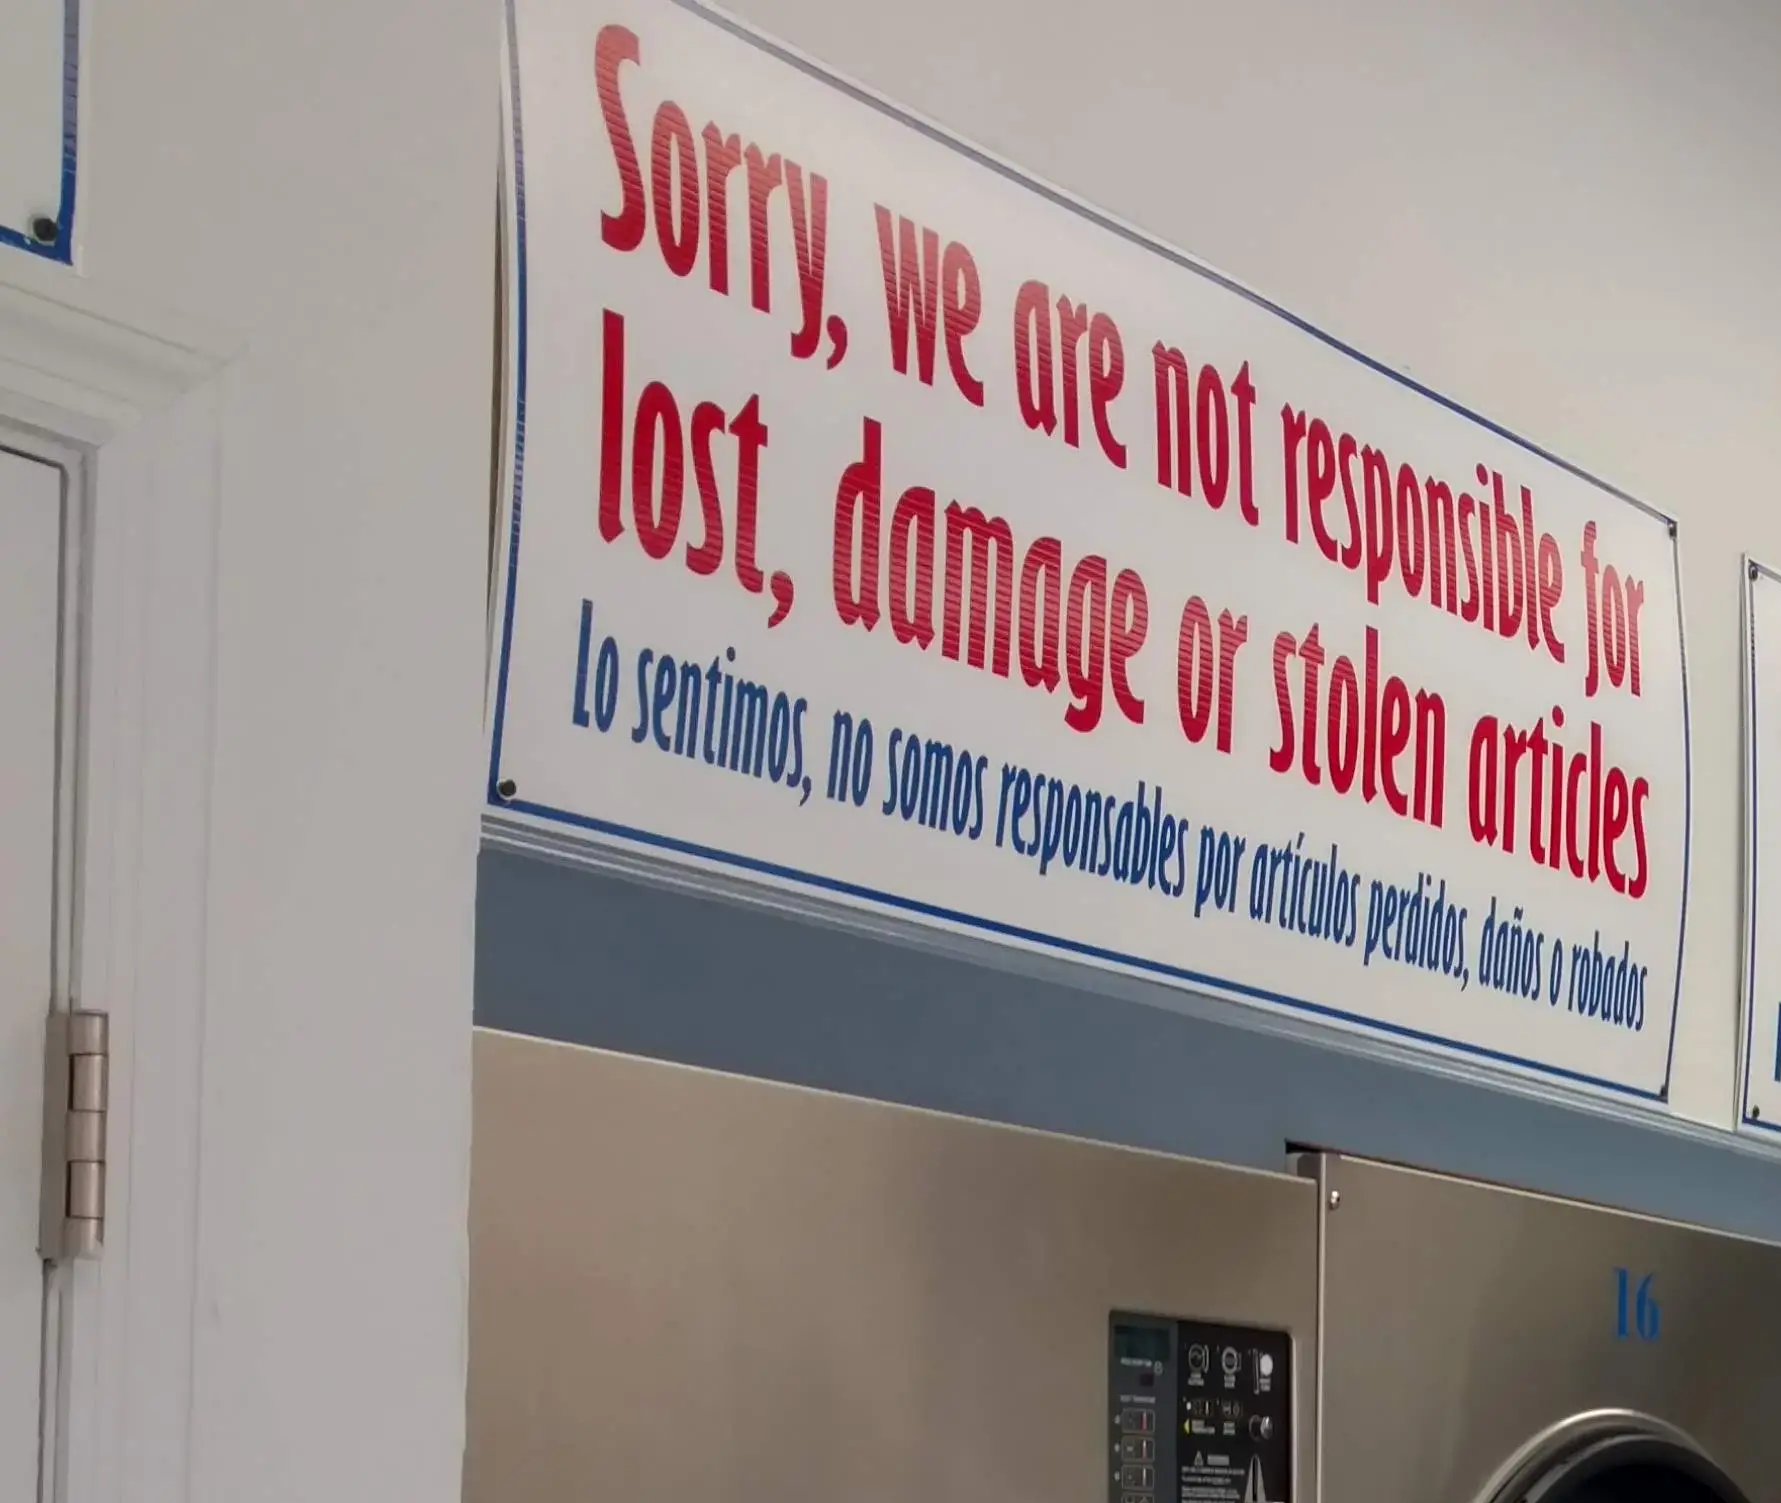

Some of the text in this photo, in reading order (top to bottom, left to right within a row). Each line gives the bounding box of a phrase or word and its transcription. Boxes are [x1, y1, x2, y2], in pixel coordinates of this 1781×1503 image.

[595, 26, 1645, 700] Sorry, we are not responsible for
[597, 308, 1650, 901] lost, damage or stolen articles
[573, 600, 1647, 1033] Lo sentimos, no somos responsables por artículos perdidos, daños o robados
[1611, 1267, 1660, 1341] 16
